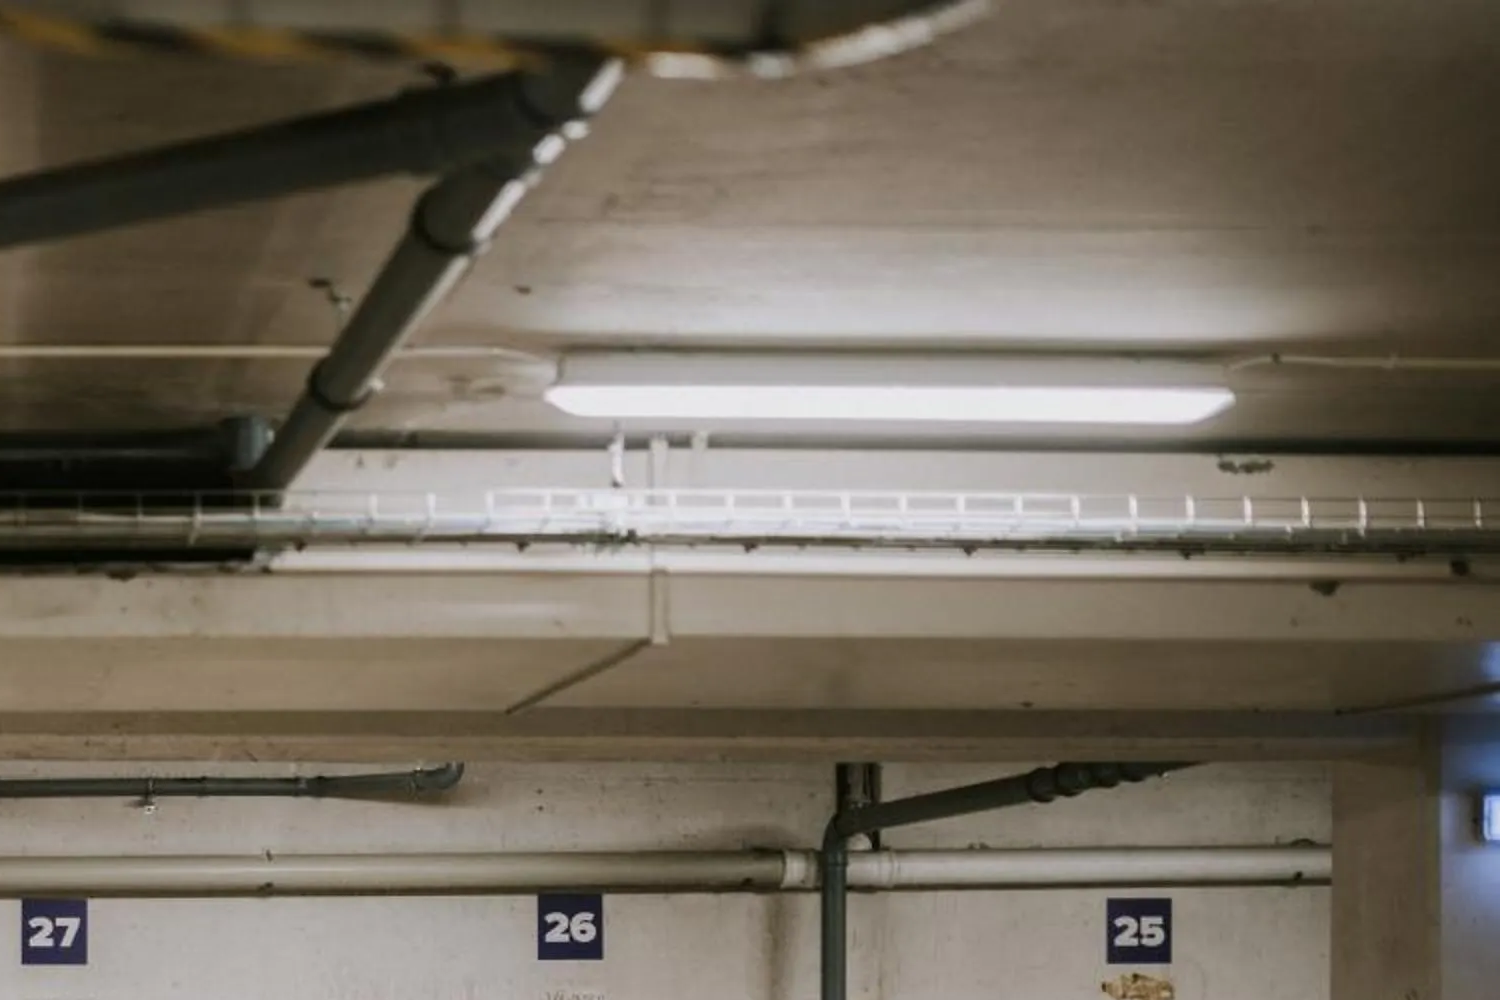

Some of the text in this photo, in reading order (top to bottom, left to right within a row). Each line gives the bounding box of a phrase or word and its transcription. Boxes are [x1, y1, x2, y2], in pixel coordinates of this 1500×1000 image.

[28, 916, 81, 948] 27
[544, 911, 597, 943] 26
[1113, 915, 1165, 947] 25
